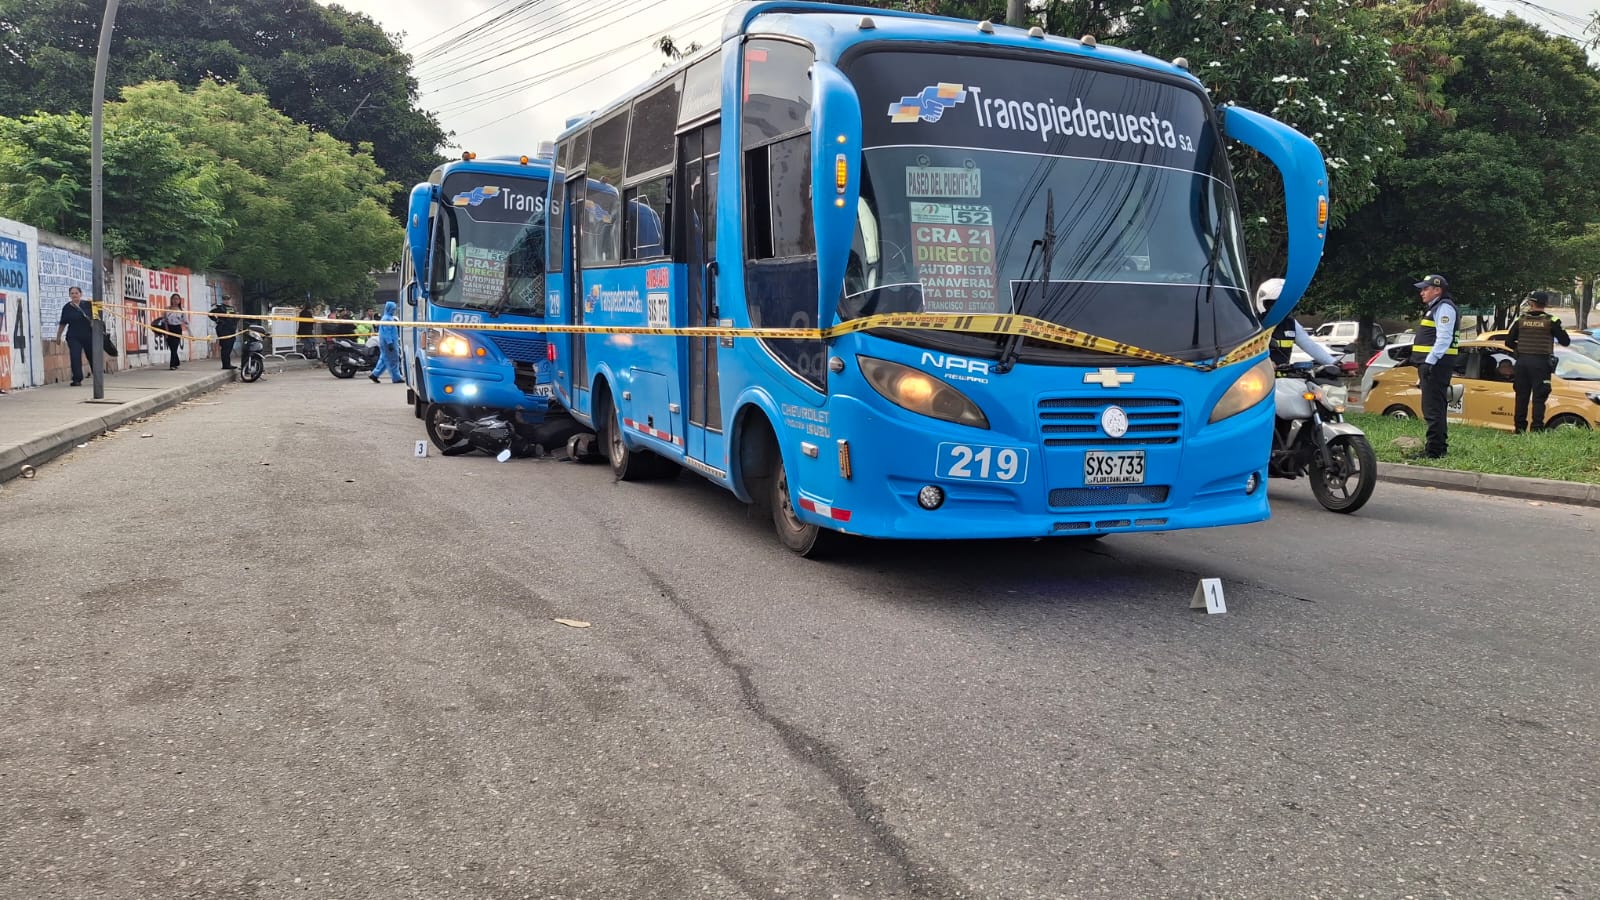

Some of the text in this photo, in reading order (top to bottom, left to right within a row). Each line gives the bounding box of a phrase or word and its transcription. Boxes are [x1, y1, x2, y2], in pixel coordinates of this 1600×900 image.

[968, 86, 1177, 149] Transpiedecuesta
[908, 172, 930, 195] PASEO
[931, 172, 943, 196] DEL
[944, 172, 968, 196] PUENTE
[957, 211, 990, 224] 52
[916, 226, 991, 245] CRA 21
[0, 240, 18, 261] RQUE
[917, 245, 992, 263] DIRECTO
[919, 263, 993, 276] AUTOPISTA
[148, 270, 158, 290] EL
[160, 272, 179, 293] POTE
[919, 275, 994, 289] CAÑAVERAL
[945, 288, 968, 299] DEL
[971, 289, 995, 300] SOL
[927, 301, 964, 311] FRANCISCO
[947, 445, 1019, 481] 219
[1210, 583, 1219, 608] 1
